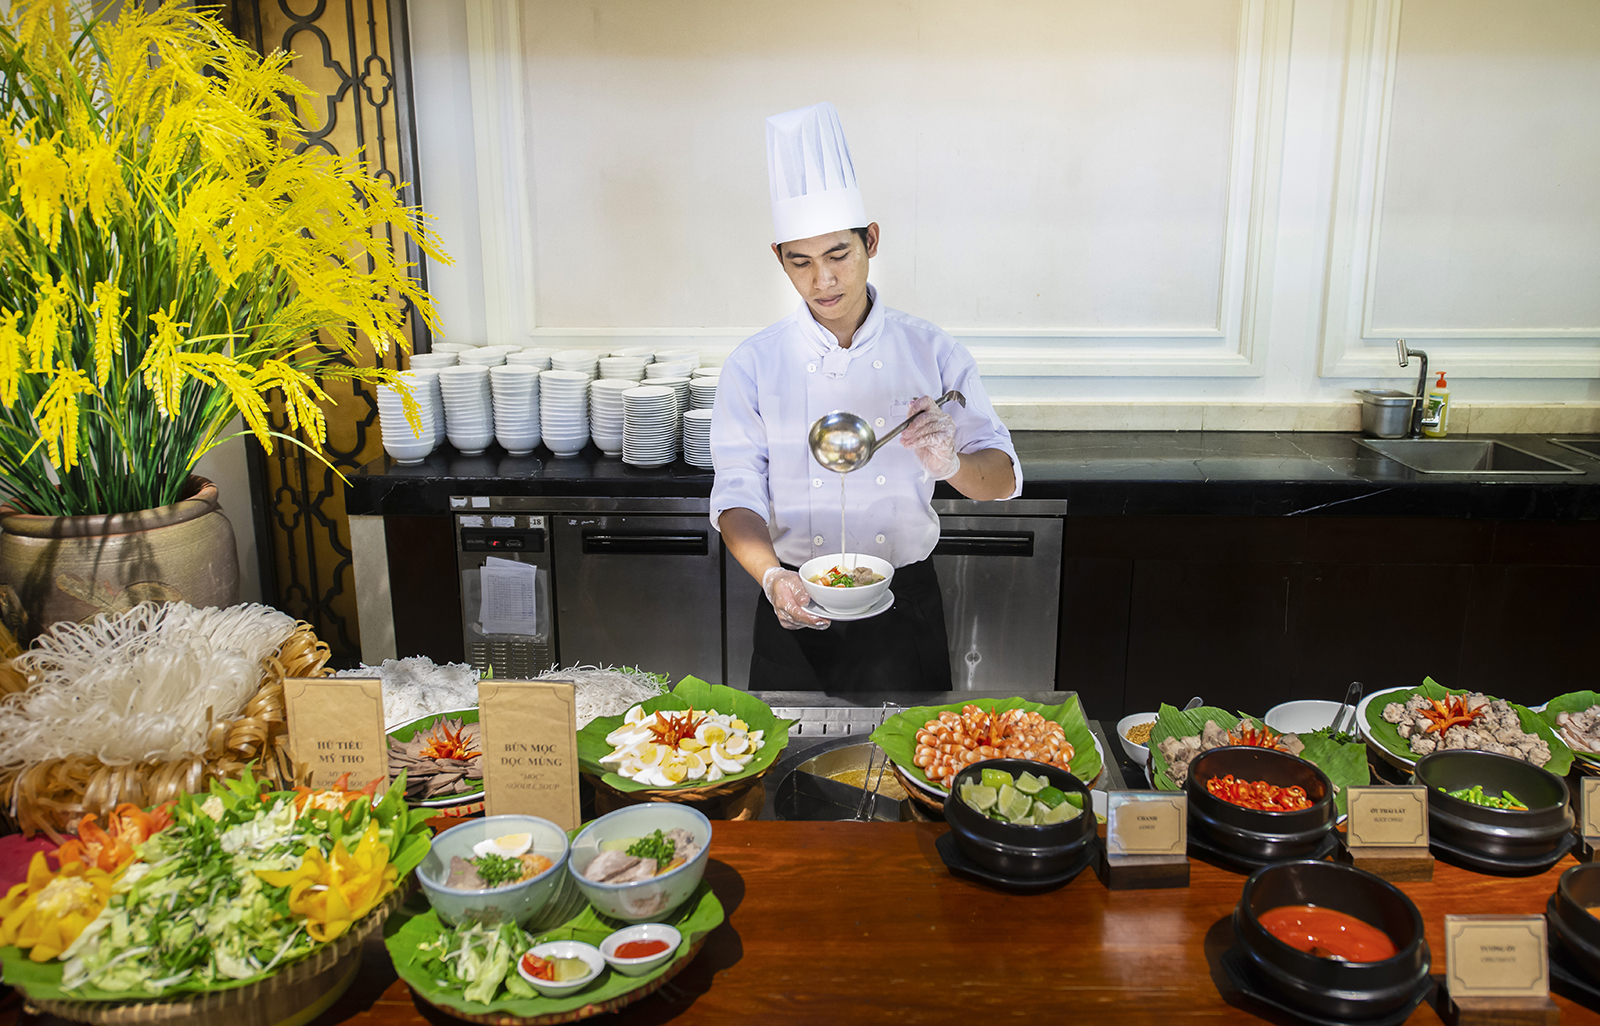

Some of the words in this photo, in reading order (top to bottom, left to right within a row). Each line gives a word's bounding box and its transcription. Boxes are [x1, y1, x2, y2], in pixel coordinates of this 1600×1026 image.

[505, 741, 528, 752] BÚN
[530, 743, 558, 755] MỌC
[319, 753, 336, 763] MỸ
[339, 754, 365, 763] THO
[501, 757, 525, 768] DỌC
